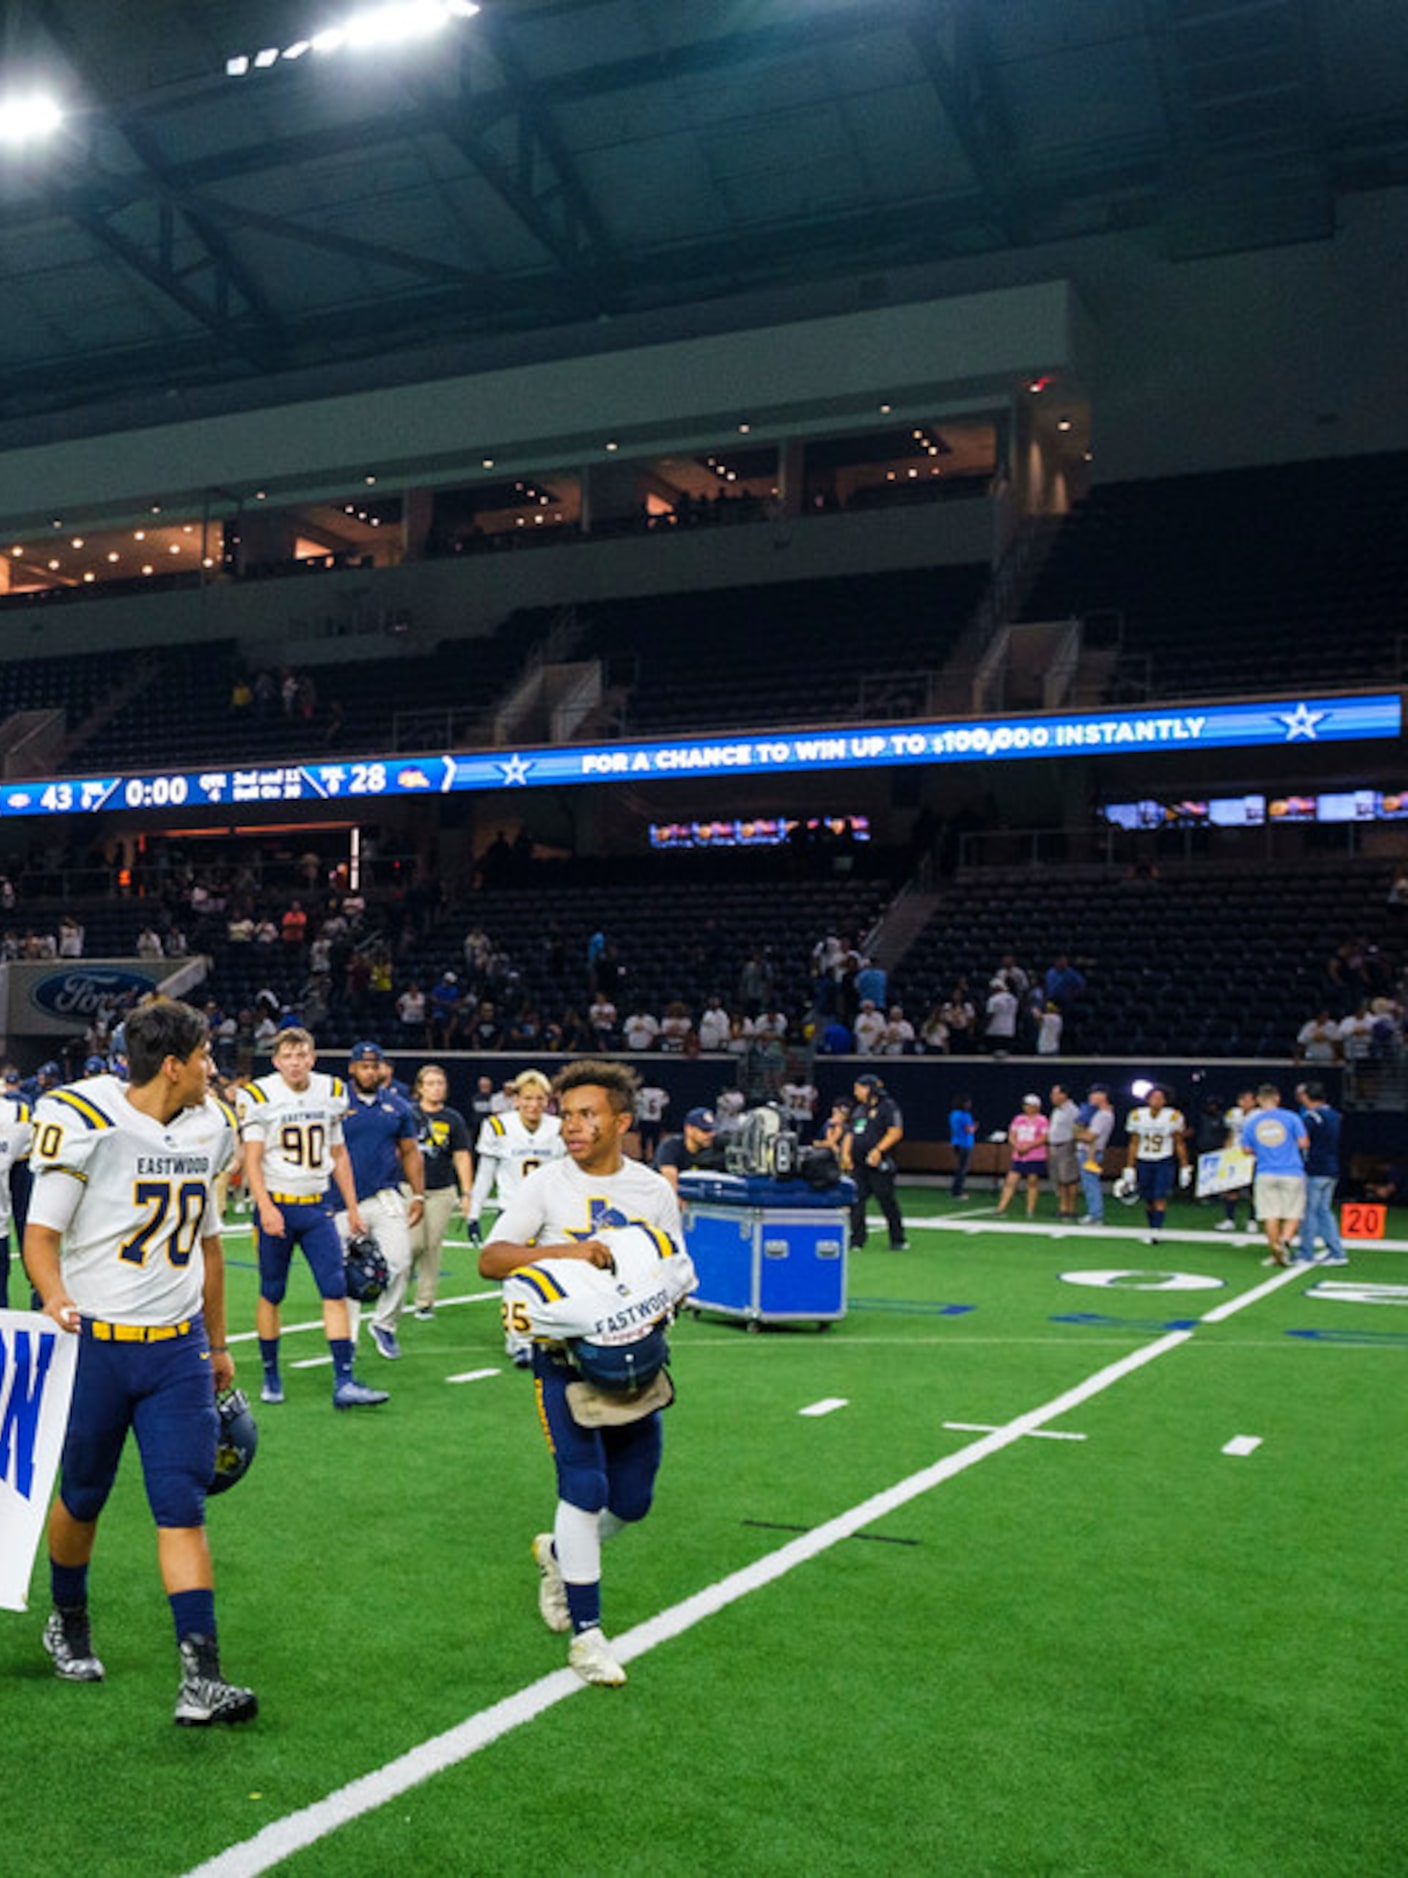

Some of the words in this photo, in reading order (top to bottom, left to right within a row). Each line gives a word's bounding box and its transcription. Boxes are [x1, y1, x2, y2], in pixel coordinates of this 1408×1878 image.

[581, 754, 628, 774] FOR
[631, 752, 650, 770] A
[655, 745, 752, 769] CHANCE
[755, 743, 789, 763] TO
[795, 739, 845, 761] WIN
[850, 736, 886, 757] UP
[892, 735, 927, 756] TO
[932, 727, 1049, 755] $100,000
[1055, 717, 1205, 747] INSTANTLY
[125, 774, 188, 808] 0:00
[349, 763, 387, 793] 28
[40, 785, 72, 811] 43
[280, 1122, 325, 1169] 90
[137, 1156, 210, 1175] EASTWOOD
[117, 1178, 207, 1270] 70
[1347, 1209, 1379, 1233] 20
